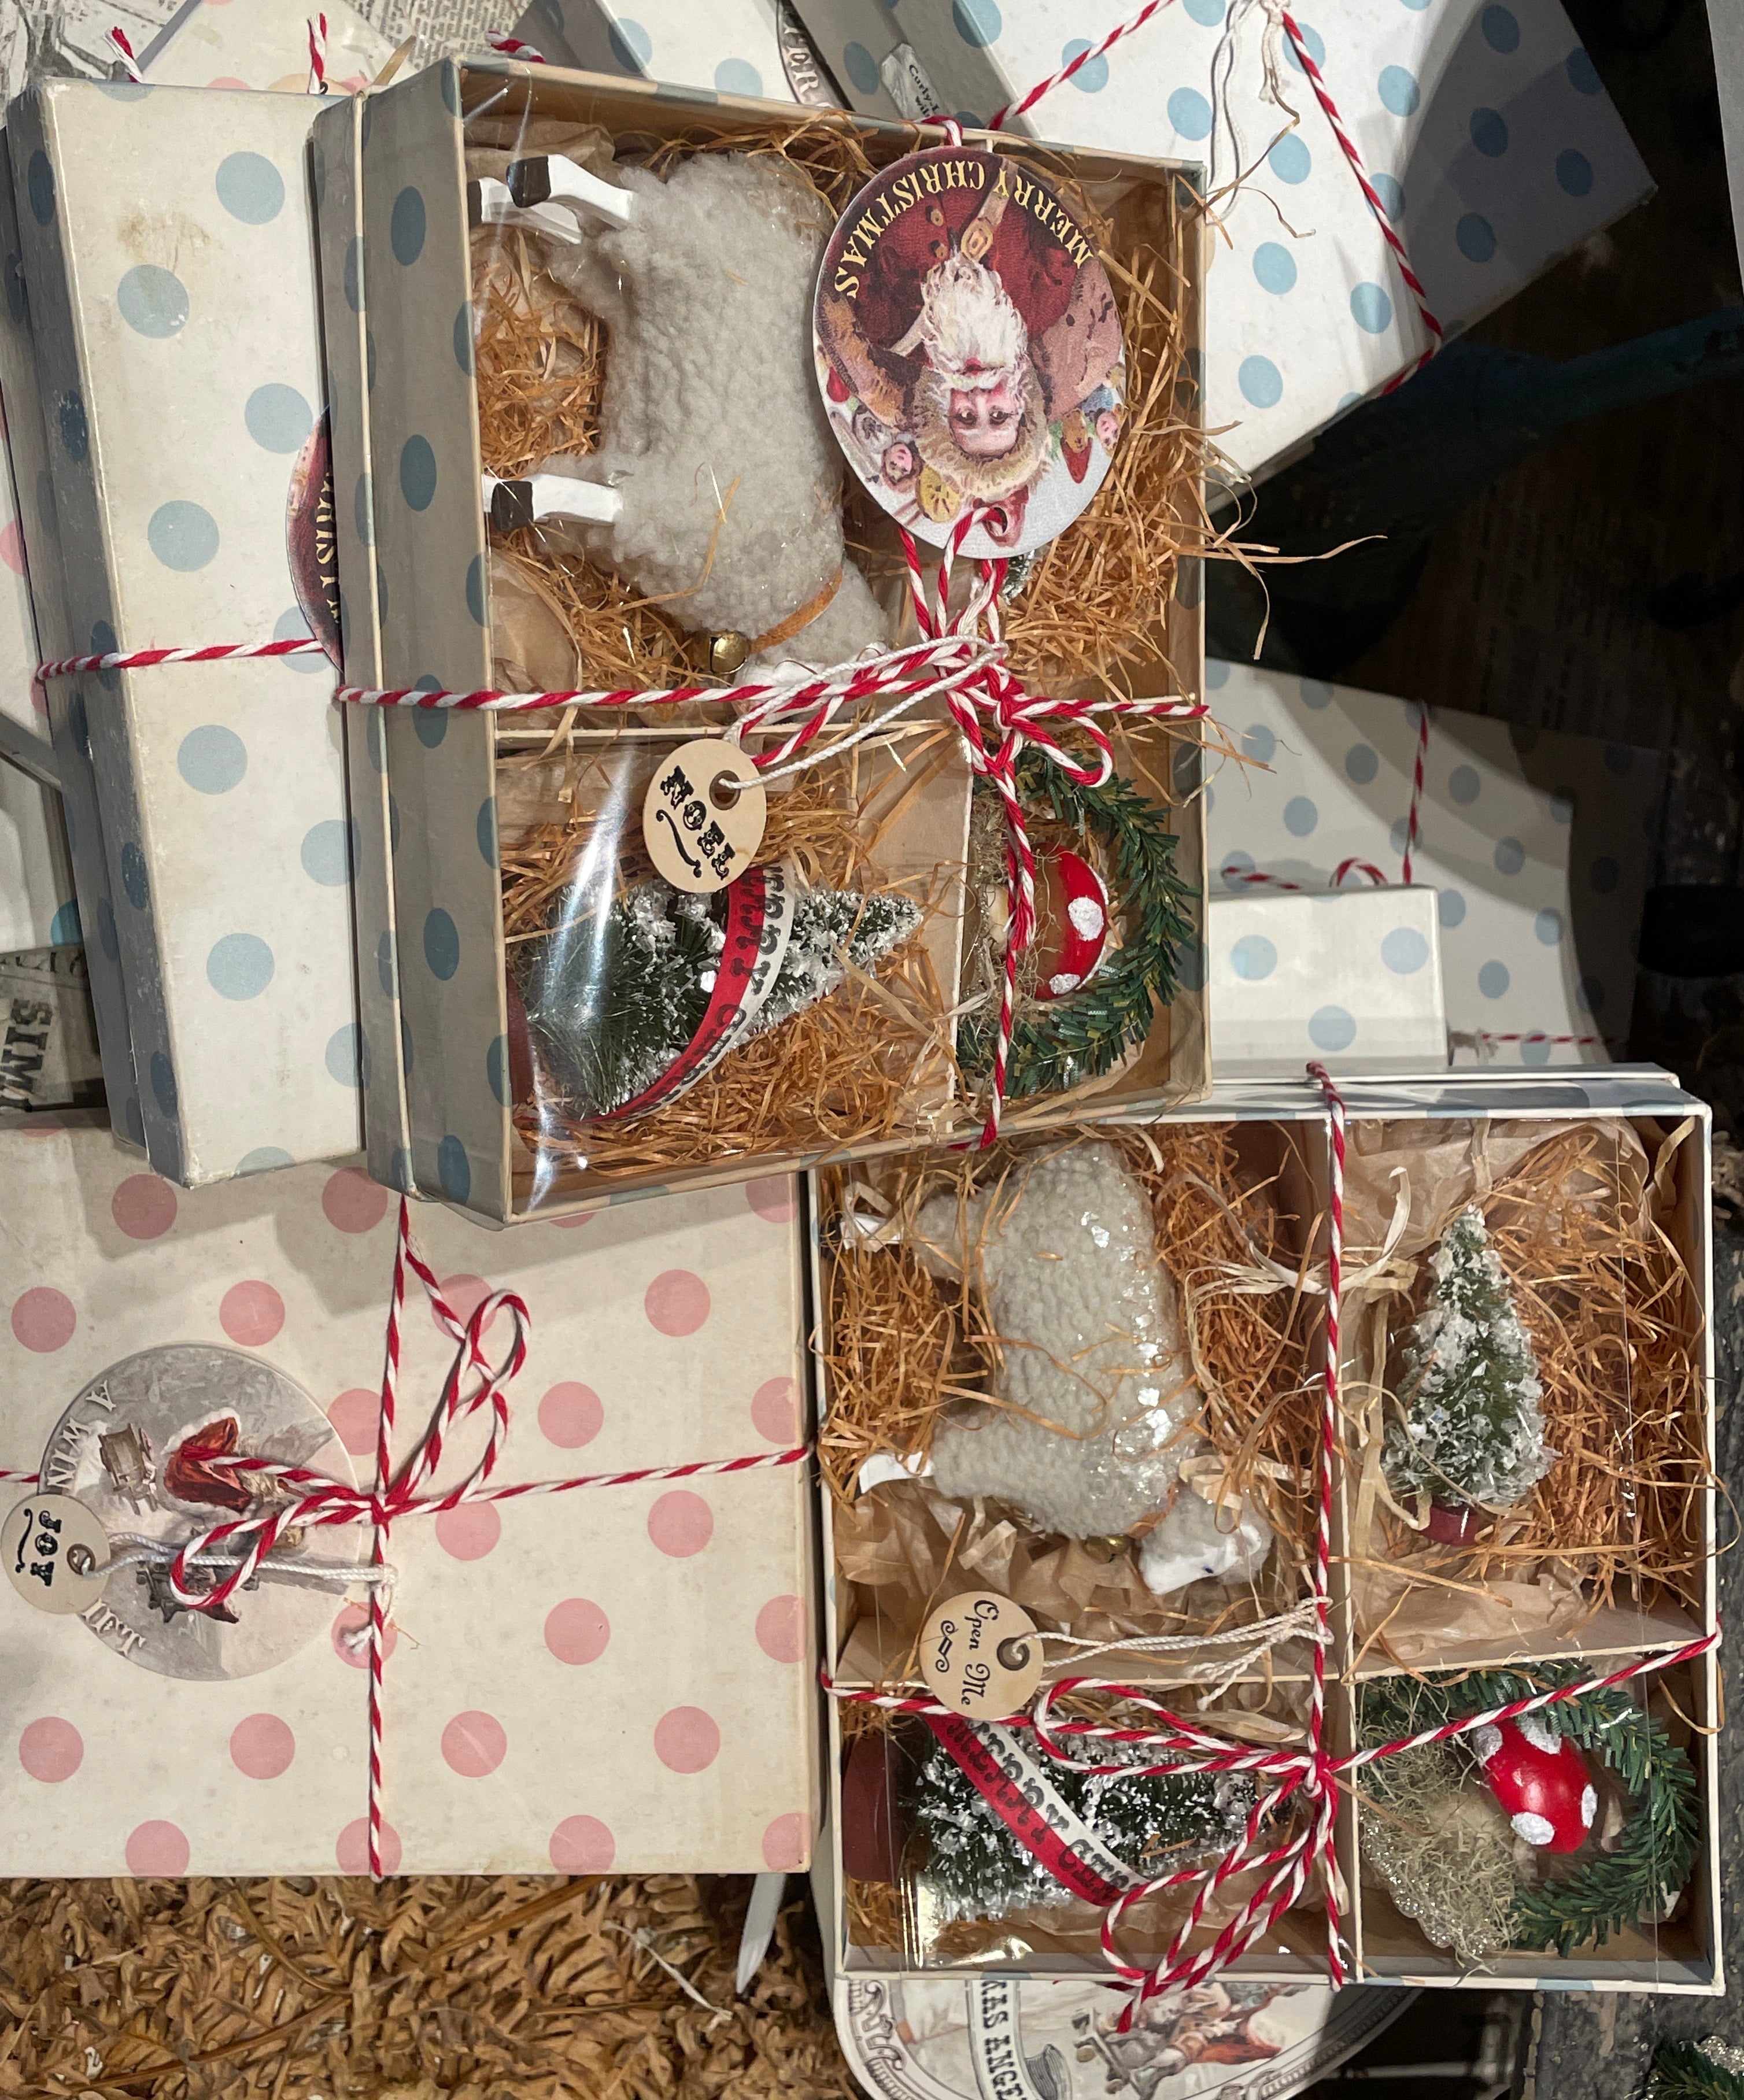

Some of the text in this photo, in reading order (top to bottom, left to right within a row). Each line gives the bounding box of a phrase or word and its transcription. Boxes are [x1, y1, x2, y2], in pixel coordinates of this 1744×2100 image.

[833, 161, 1094, 299] MERRY CHRISTMAS
[660, 764, 736, 880] NOEL
[30, 1510, 62, 1587] JOY
[47, 1380, 147, 1657] A WIN IFT
[960, 1599, 1000, 1706] Open Me
[984, 2035, 1027, 2100] ANGE
